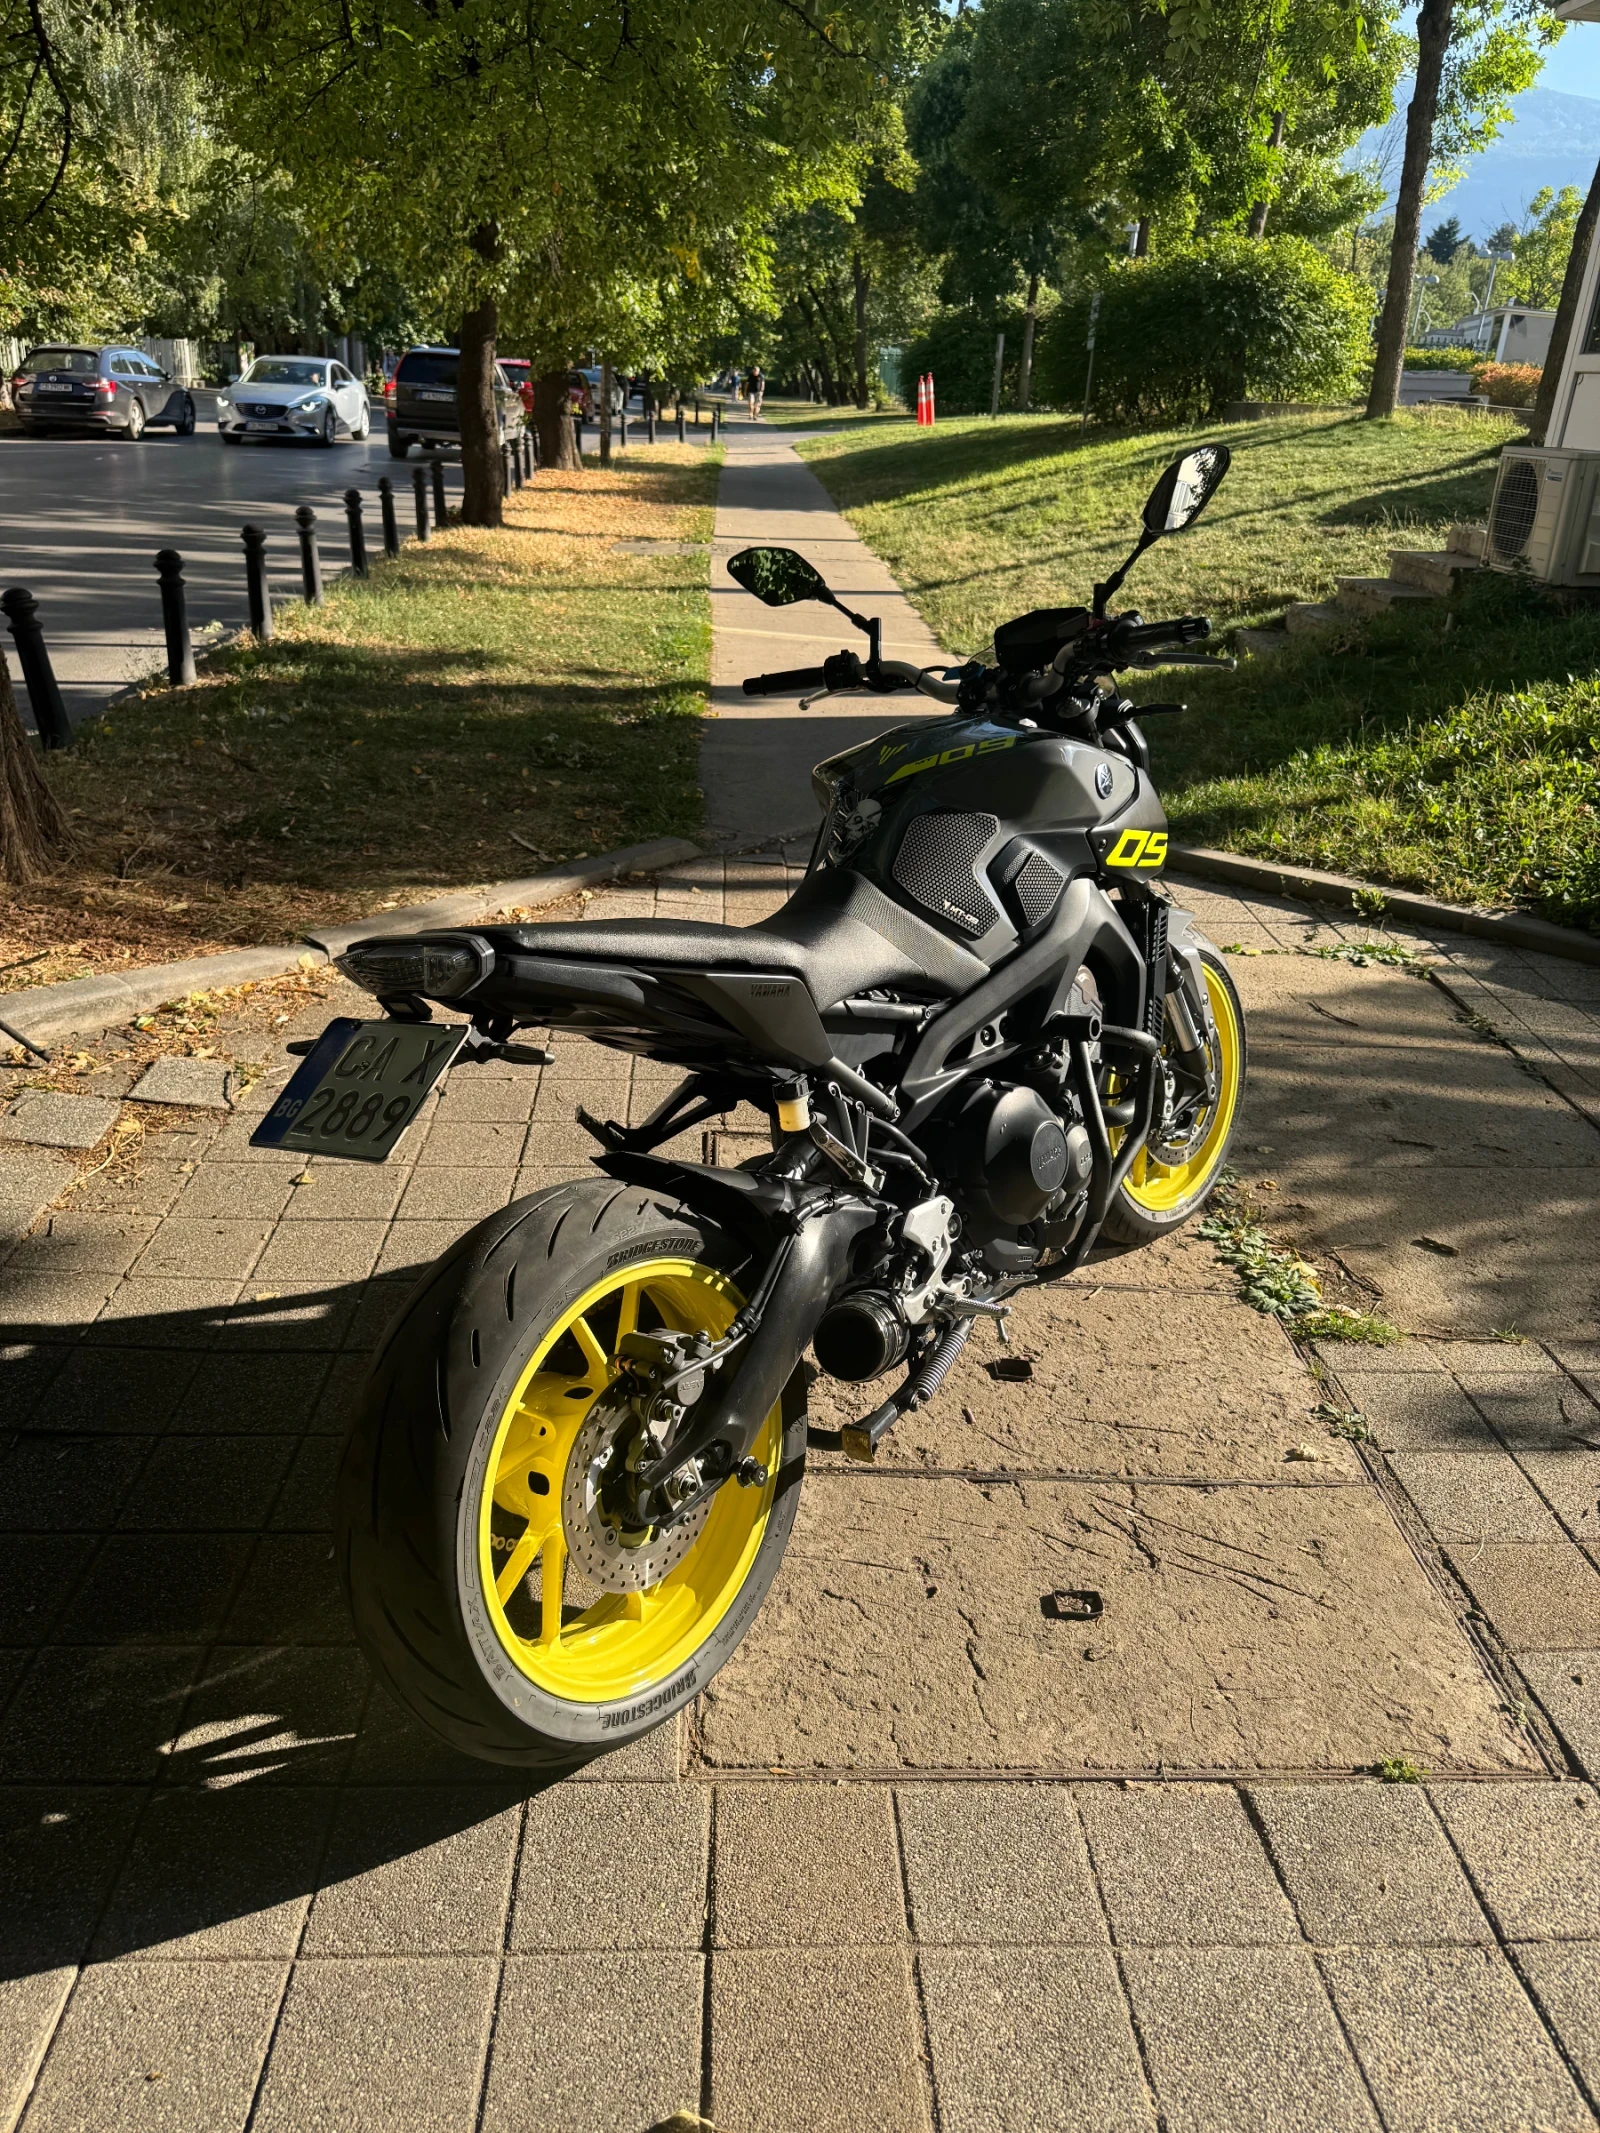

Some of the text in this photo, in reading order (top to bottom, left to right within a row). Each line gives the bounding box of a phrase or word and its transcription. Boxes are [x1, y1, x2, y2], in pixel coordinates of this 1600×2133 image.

[939, 735, 1017, 765] 09
[950, 905, 979, 925] MT-09
[750, 984, 791, 998] YAMAHA
[334, 1035, 451, 1085] CA X
[274, 1098, 303, 1118] BG
[290, 1087, 412, 1142] 2889
[605, 1237, 700, 1270] BRIDGESTONE
[601, 1668, 697, 1730] BRIDGESTONE
